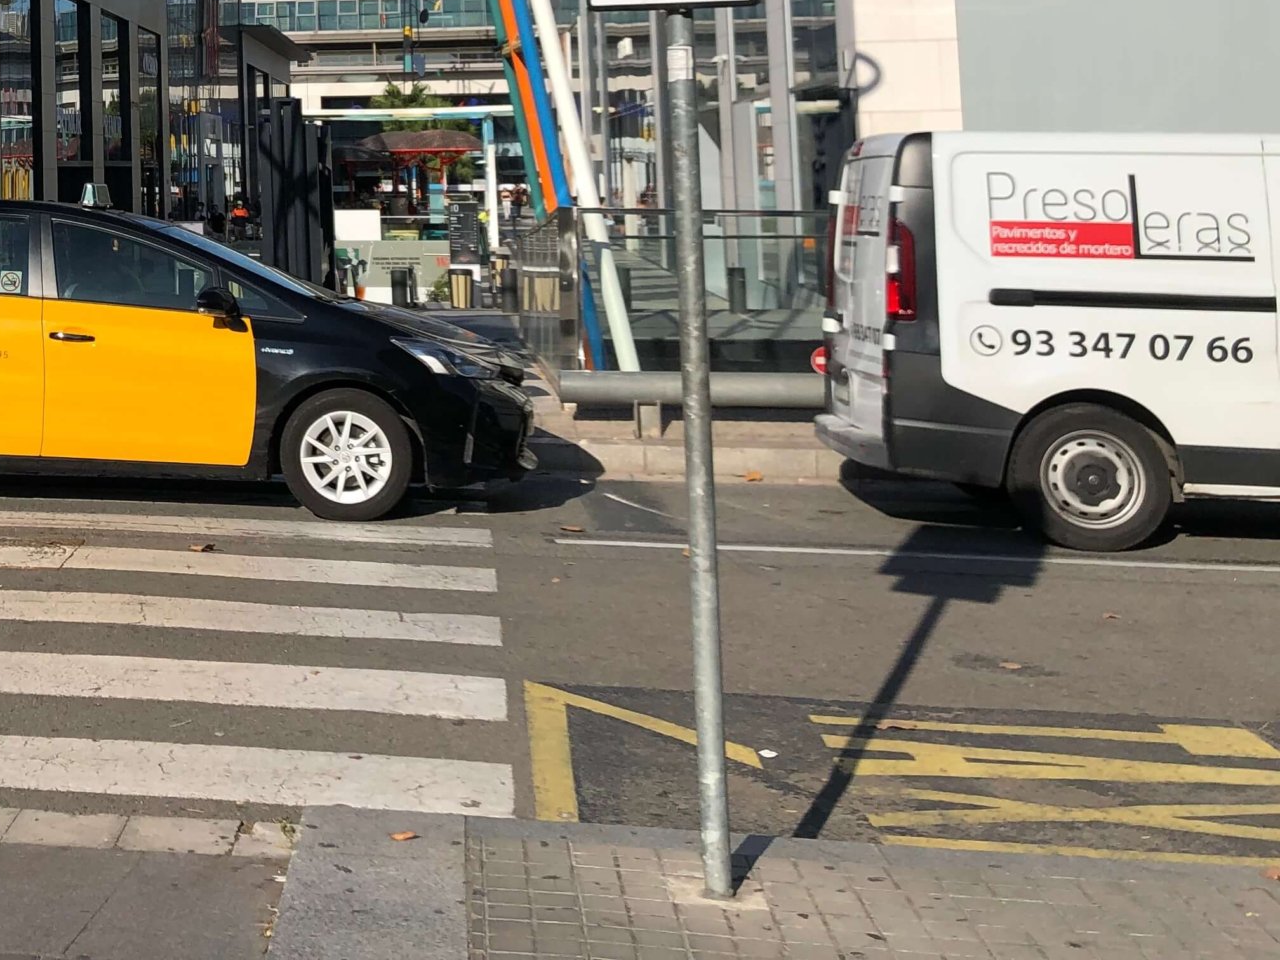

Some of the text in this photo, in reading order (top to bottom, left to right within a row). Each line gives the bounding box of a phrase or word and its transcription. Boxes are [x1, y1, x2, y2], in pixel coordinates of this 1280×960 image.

[992, 225, 1077, 241] Pavimentos y
[992, 242, 1132, 255] recrecidos de mortero
[1010, 329, 1254, 364] 93 347 07 66
